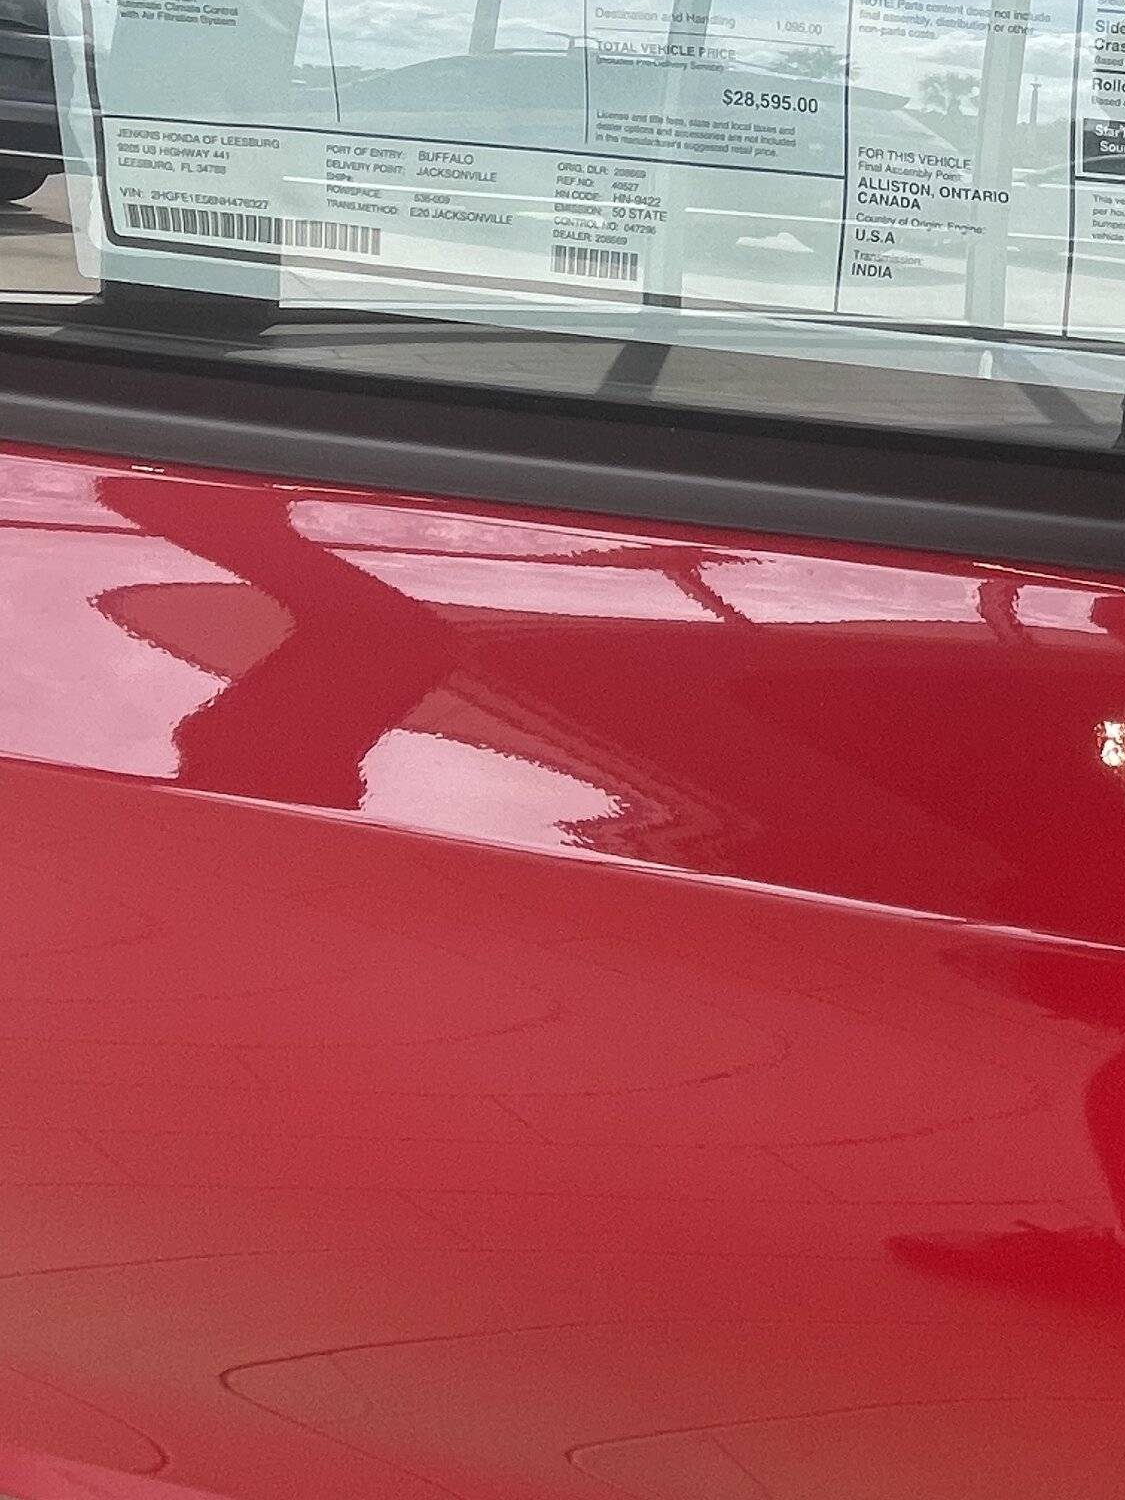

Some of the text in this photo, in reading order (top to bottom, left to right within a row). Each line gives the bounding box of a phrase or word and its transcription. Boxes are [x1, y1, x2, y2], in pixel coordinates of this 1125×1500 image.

[722, 89, 818, 114] $28,595.00
[418, 150, 474, 165] BUFFALO
[416, 167, 497, 183] JACKSONVILLE
[857, 177, 1009, 203] ALLISTON, ONTARIO
[857, 192, 921, 210] CANADA
[852, 263, 892, 279] INDIA
